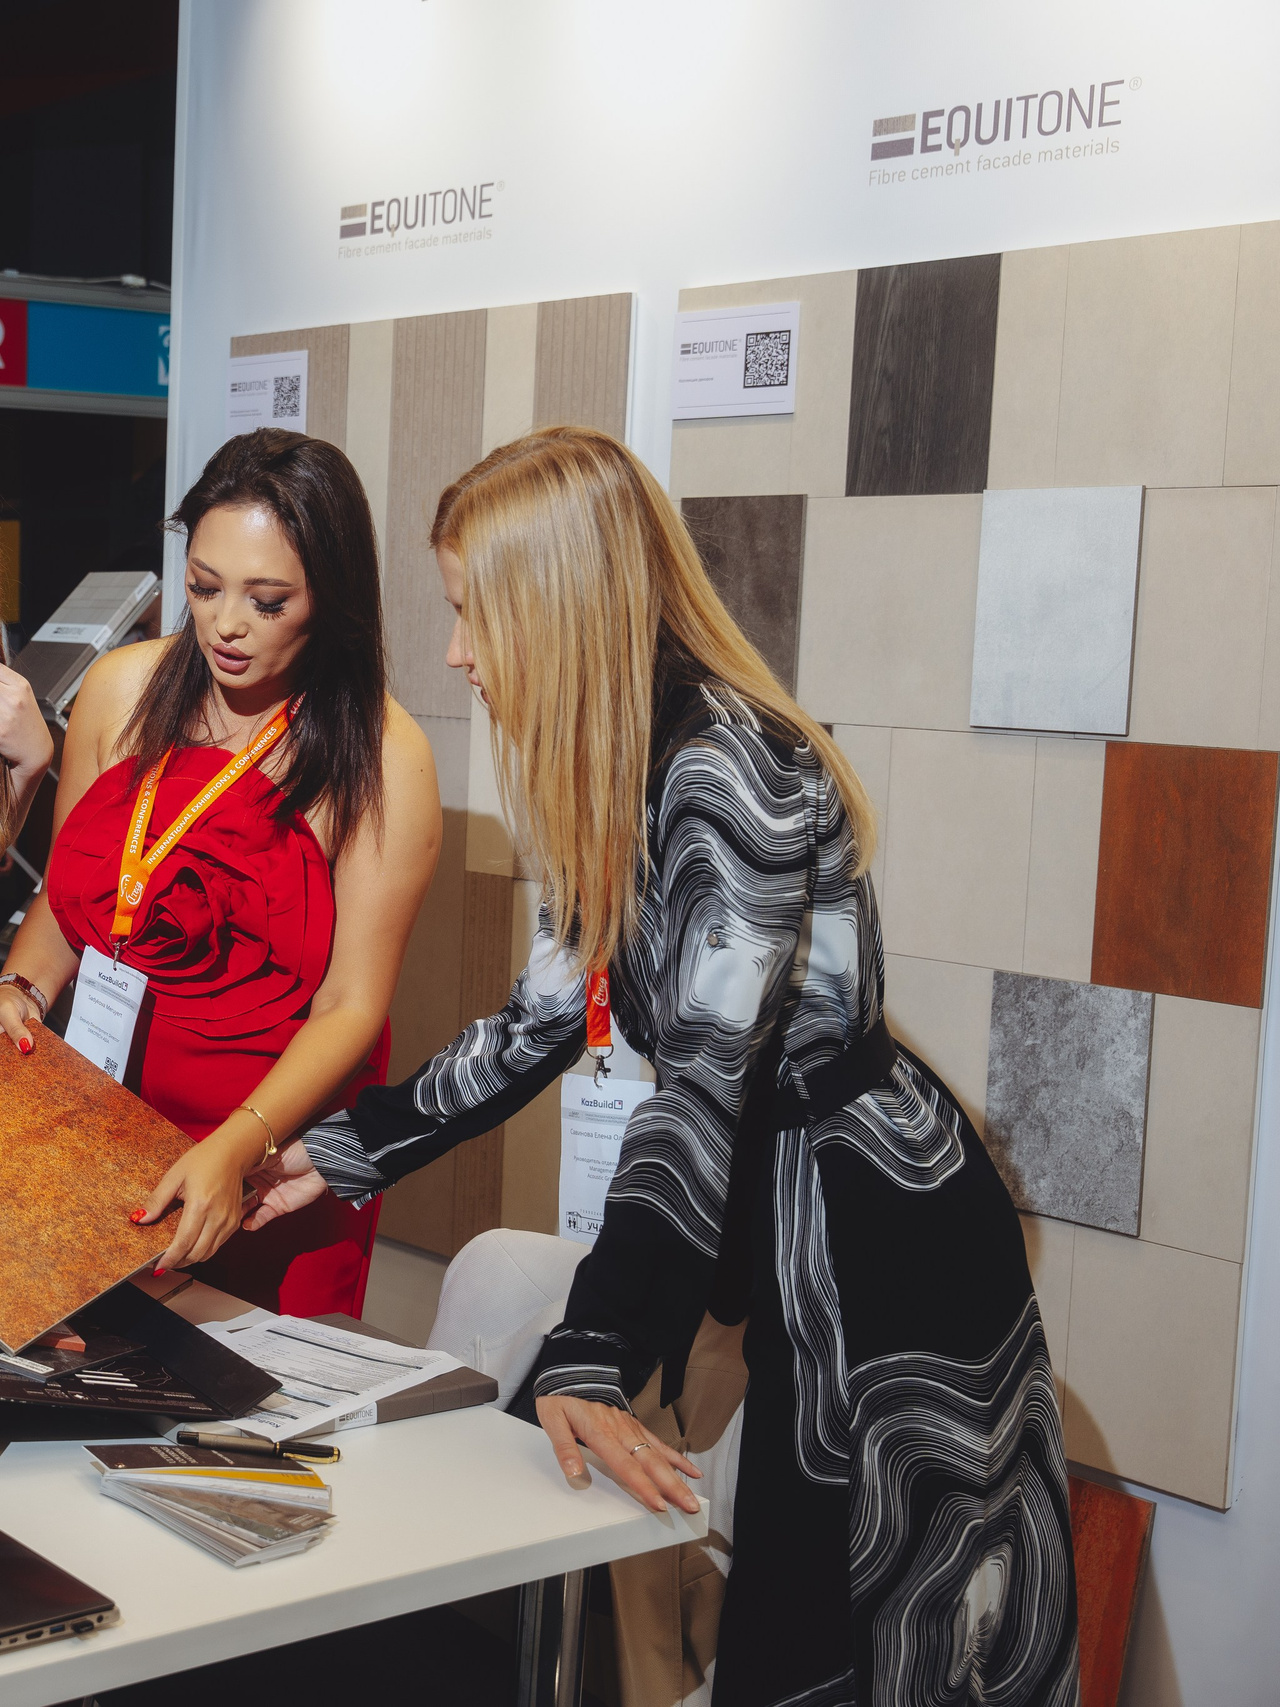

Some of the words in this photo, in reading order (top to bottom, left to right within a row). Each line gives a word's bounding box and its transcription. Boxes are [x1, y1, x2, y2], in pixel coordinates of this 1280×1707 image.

[920, 79, 1124, 156] EQUITONE
[869, 168, 906, 187] Fibre
[911, 158, 971, 181] cement
[976, 149, 1032, 173] facade
[1037, 137, 1120, 163] materials
[370, 182, 494, 237] EQUITONE
[691, 339, 738, 355] EQUITONE
[147, 813, 193, 865] INTERNATIONAL
[191, 773, 231, 813] EXHIBITIONS
[230, 768, 236, 776] &
[234, 726, 277, 769] CONFERENCES
[129, 798, 149, 854] CONFERENCES
[98, 971, 122, 988] KazBuild
[581, 1097, 614, 1109] KazBuild
[588, 1165, 616, 1174] Managemen
